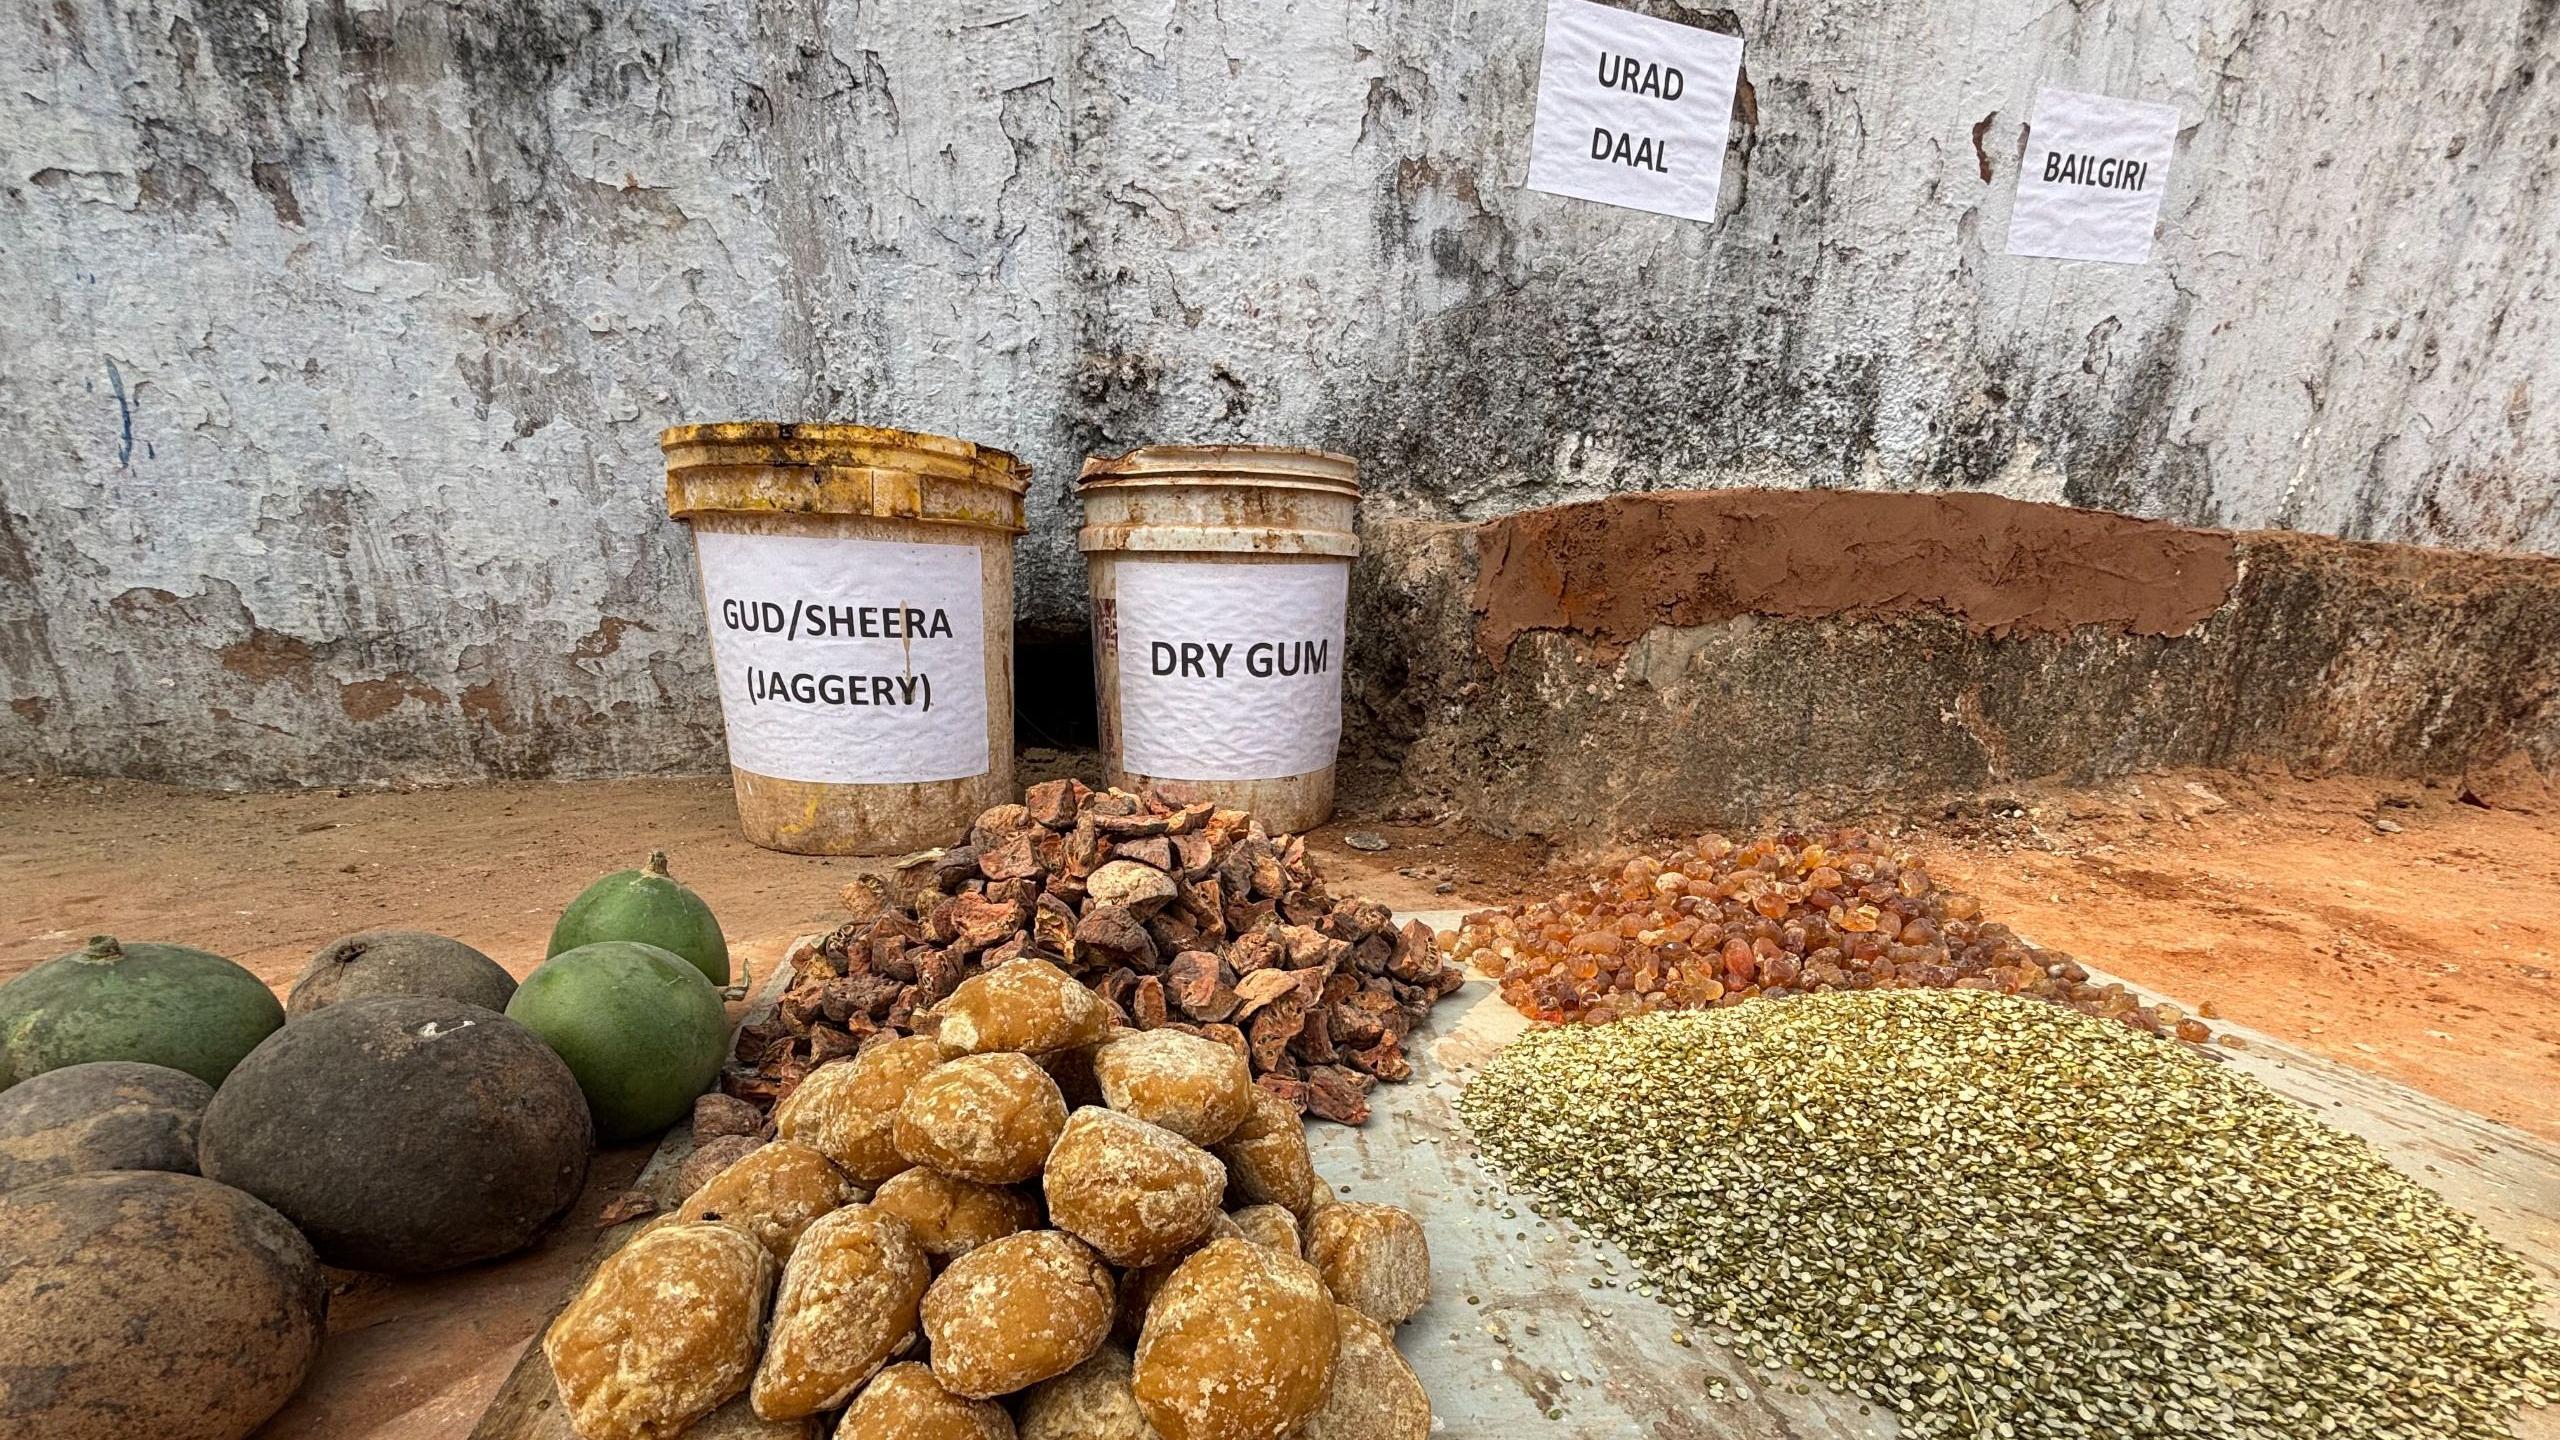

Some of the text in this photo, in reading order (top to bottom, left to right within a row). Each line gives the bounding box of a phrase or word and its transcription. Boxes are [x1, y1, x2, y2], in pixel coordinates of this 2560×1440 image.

[1596, 51, 1685, 102] URAD
[1590, 126, 1669, 175] DAAL
[2042, 150, 2149, 192] BAILGIRI
[722, 597, 954, 642] GUD/SHEERA
[1150, 637, 1330, 679] DRY GUM
[746, 665, 931, 713] (JAGGERY)
